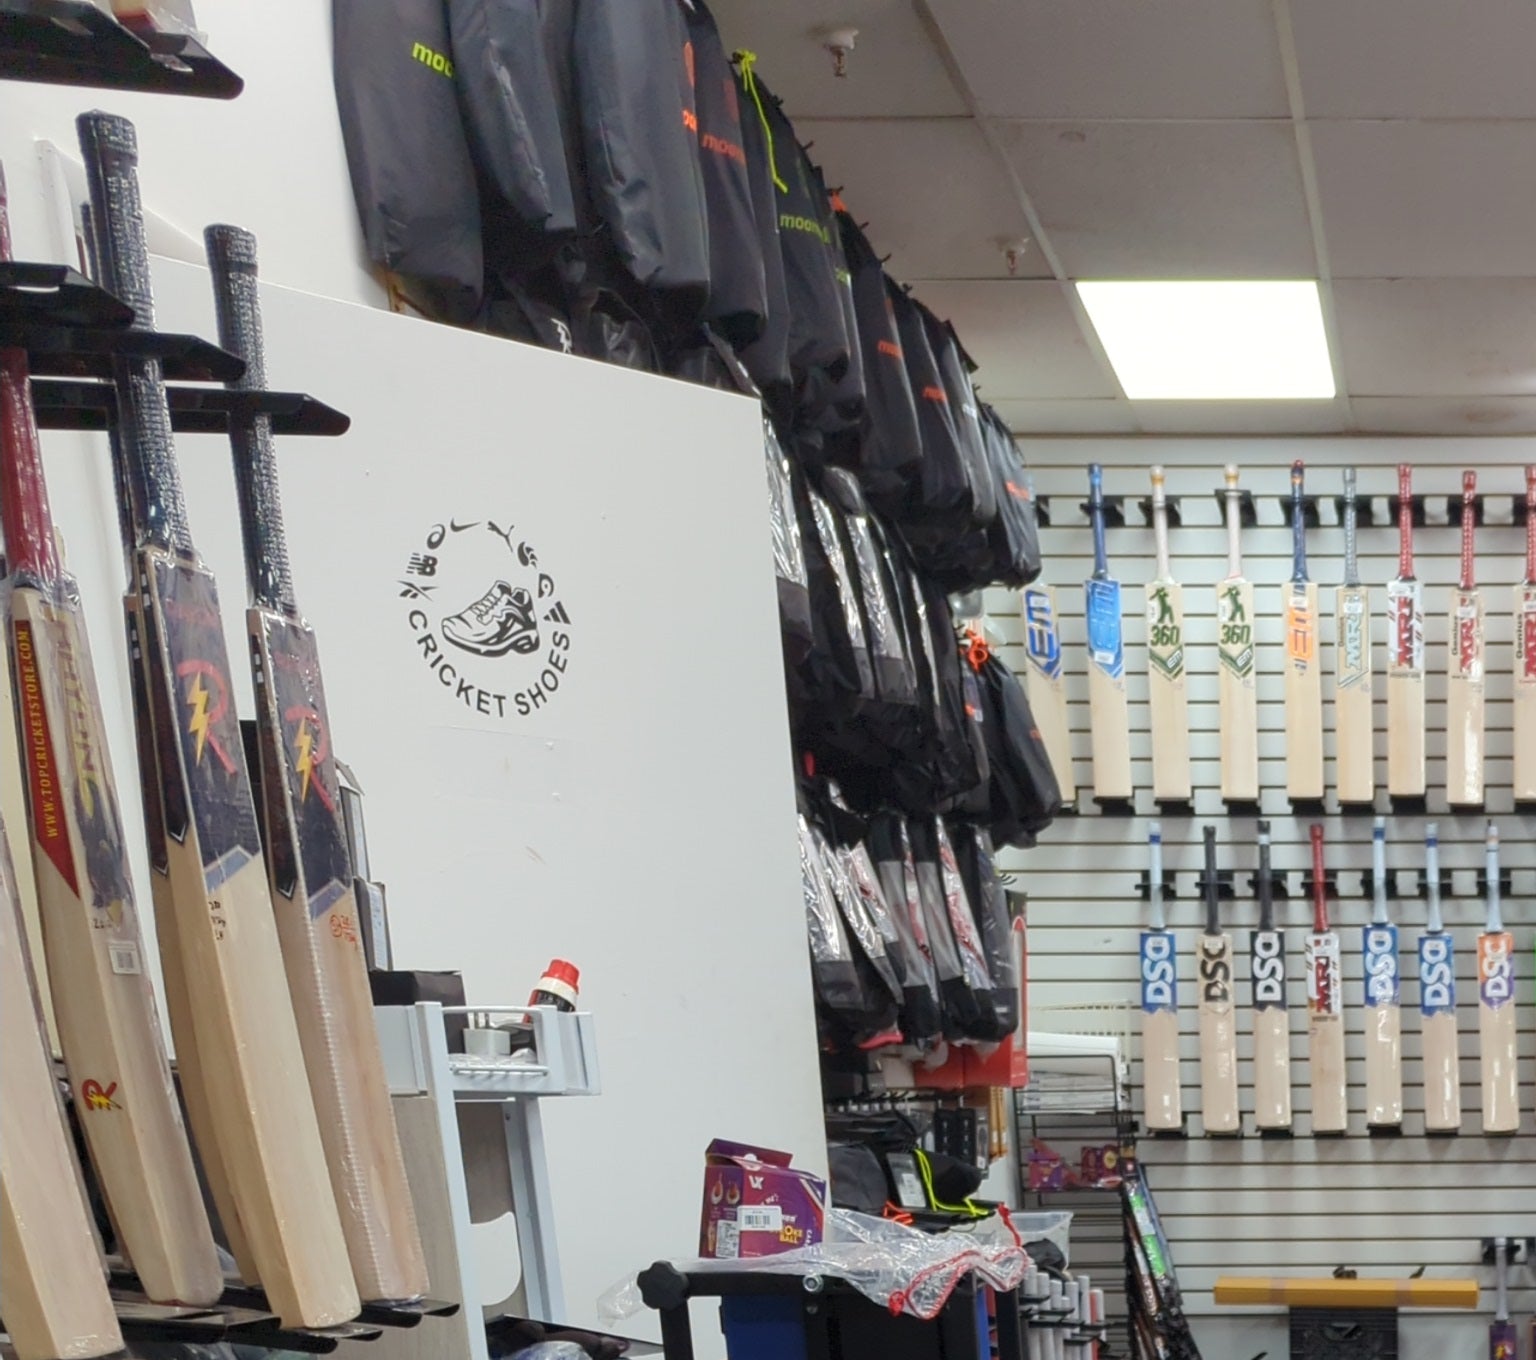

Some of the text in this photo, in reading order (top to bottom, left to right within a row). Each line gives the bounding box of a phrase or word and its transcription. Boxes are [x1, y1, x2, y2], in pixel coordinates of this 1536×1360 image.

[408, 609, 571, 718] CRICKET SHOES
[1150, 625, 1180, 646] 360
[1220, 624, 1250, 646] 360
[16, 629, 59, 839] WWW.TOPCRICKETSTORE.COM
